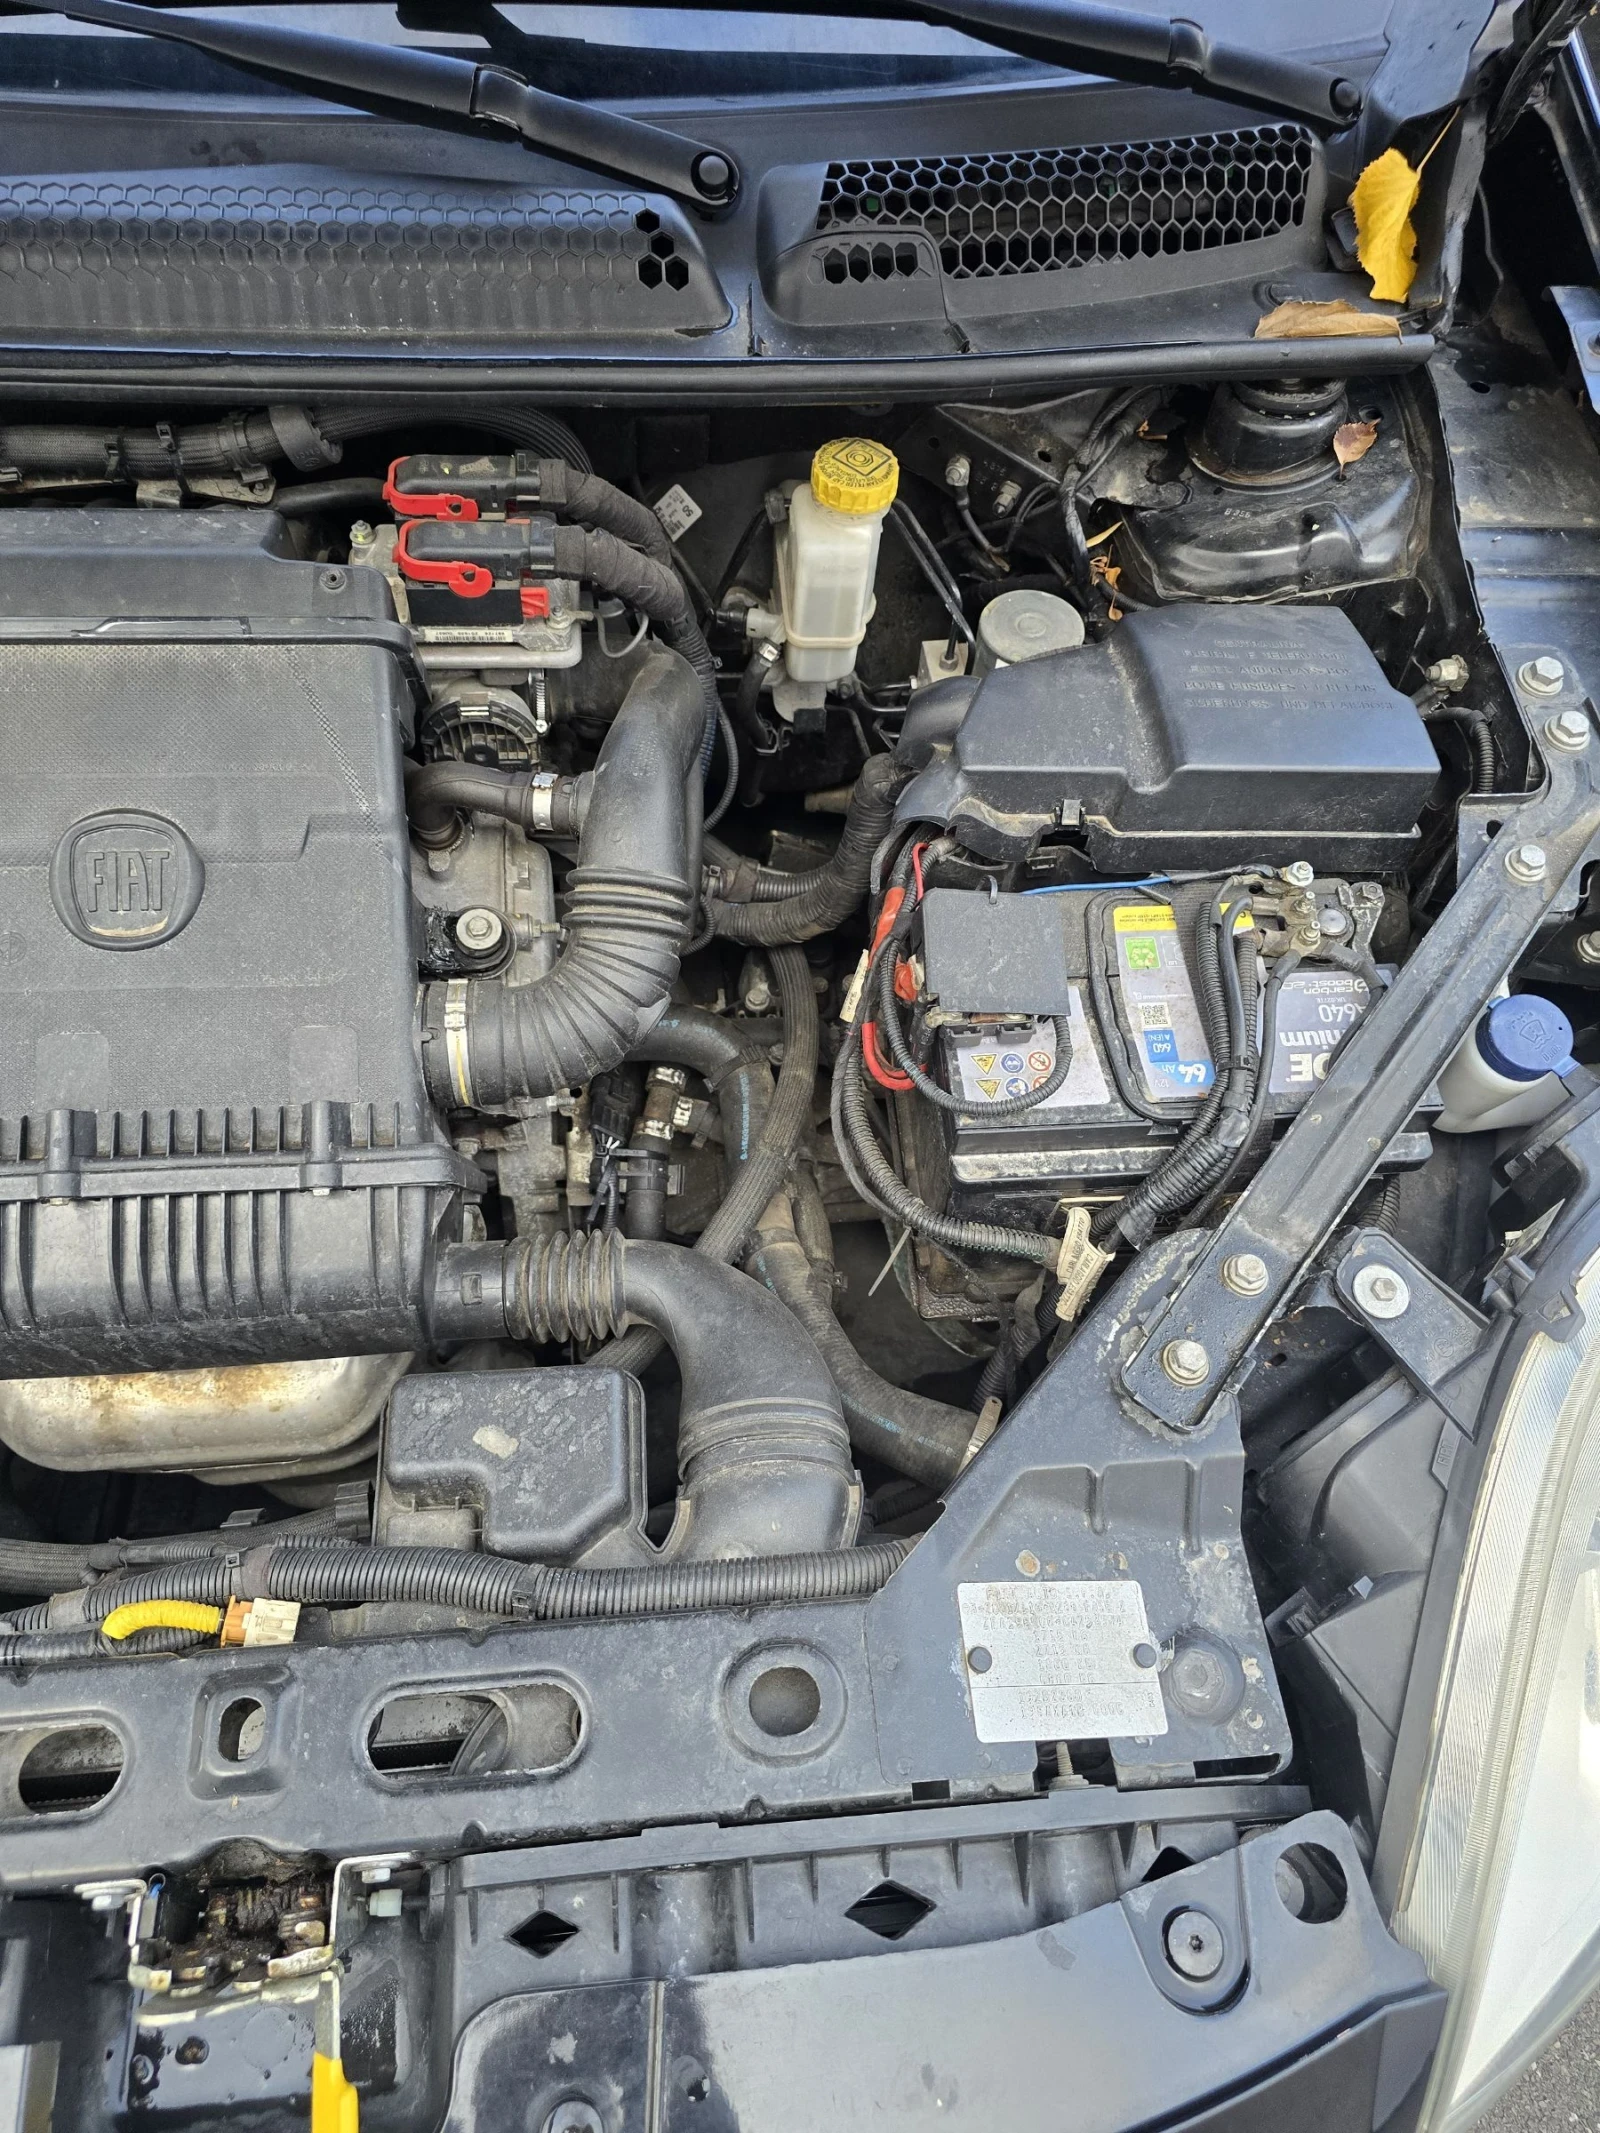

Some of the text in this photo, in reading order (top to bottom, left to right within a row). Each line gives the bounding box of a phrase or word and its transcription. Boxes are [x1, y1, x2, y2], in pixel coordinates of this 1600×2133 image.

[84, 849, 170, 913] FIAT
[1303, 987, 1354, 995] carbon
[1279, 1029, 1348, 1050] mium
[1153, 1042, 1172, 1054] 640
[1161, 1063, 1207, 1084] 64 Ah
[1153, 1078, 1170, 1089] 12V
